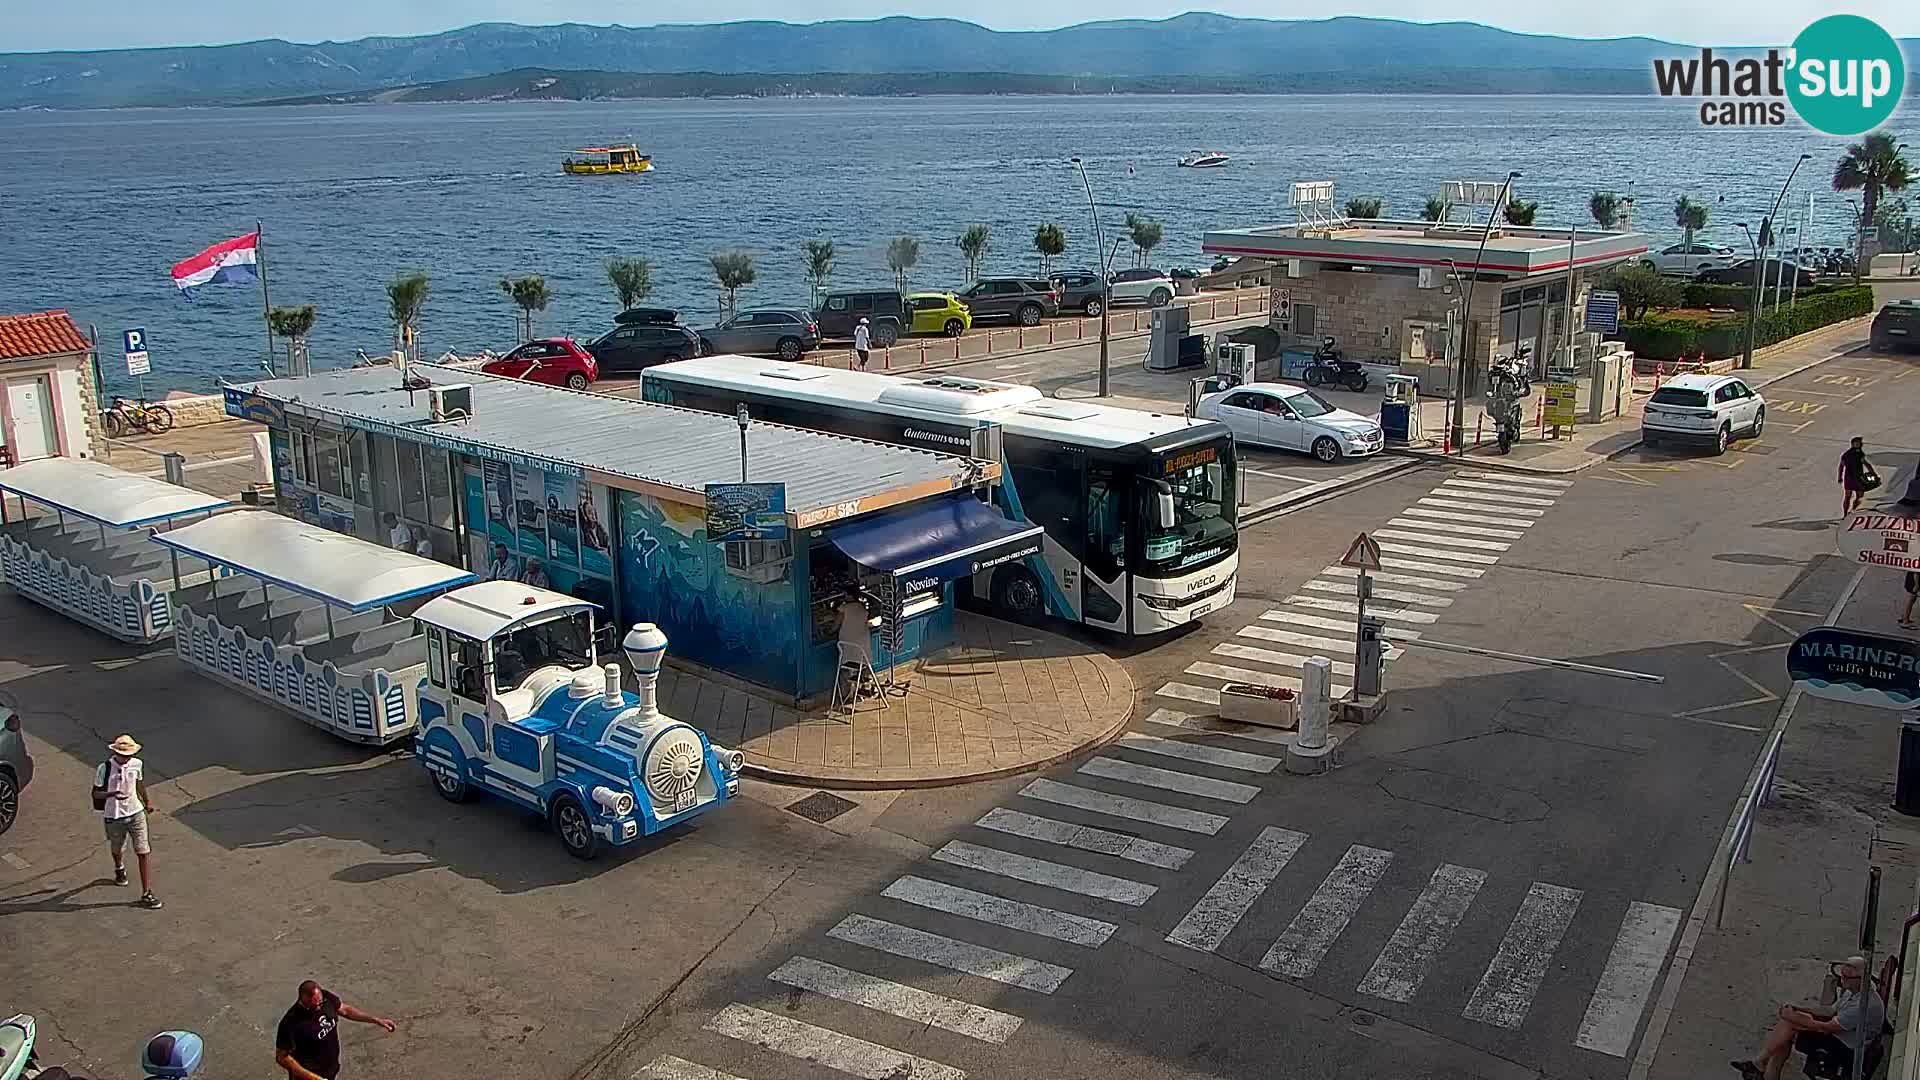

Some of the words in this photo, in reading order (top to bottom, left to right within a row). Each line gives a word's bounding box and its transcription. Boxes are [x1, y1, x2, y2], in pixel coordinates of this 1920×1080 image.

[128, 331, 142, 350] P
[435, 437, 466, 452] POSTAJA
[477, 446, 492, 458] BUS
[493, 450, 525, 465] STATION
[527, 457, 553, 472] TICKET
[554, 463, 582, 478] OFFICE
[1880, 530, 1915, 541] GRILL
[1187, 574, 1217, 593] IVECO
[1869, 665, 1896, 680] bar
